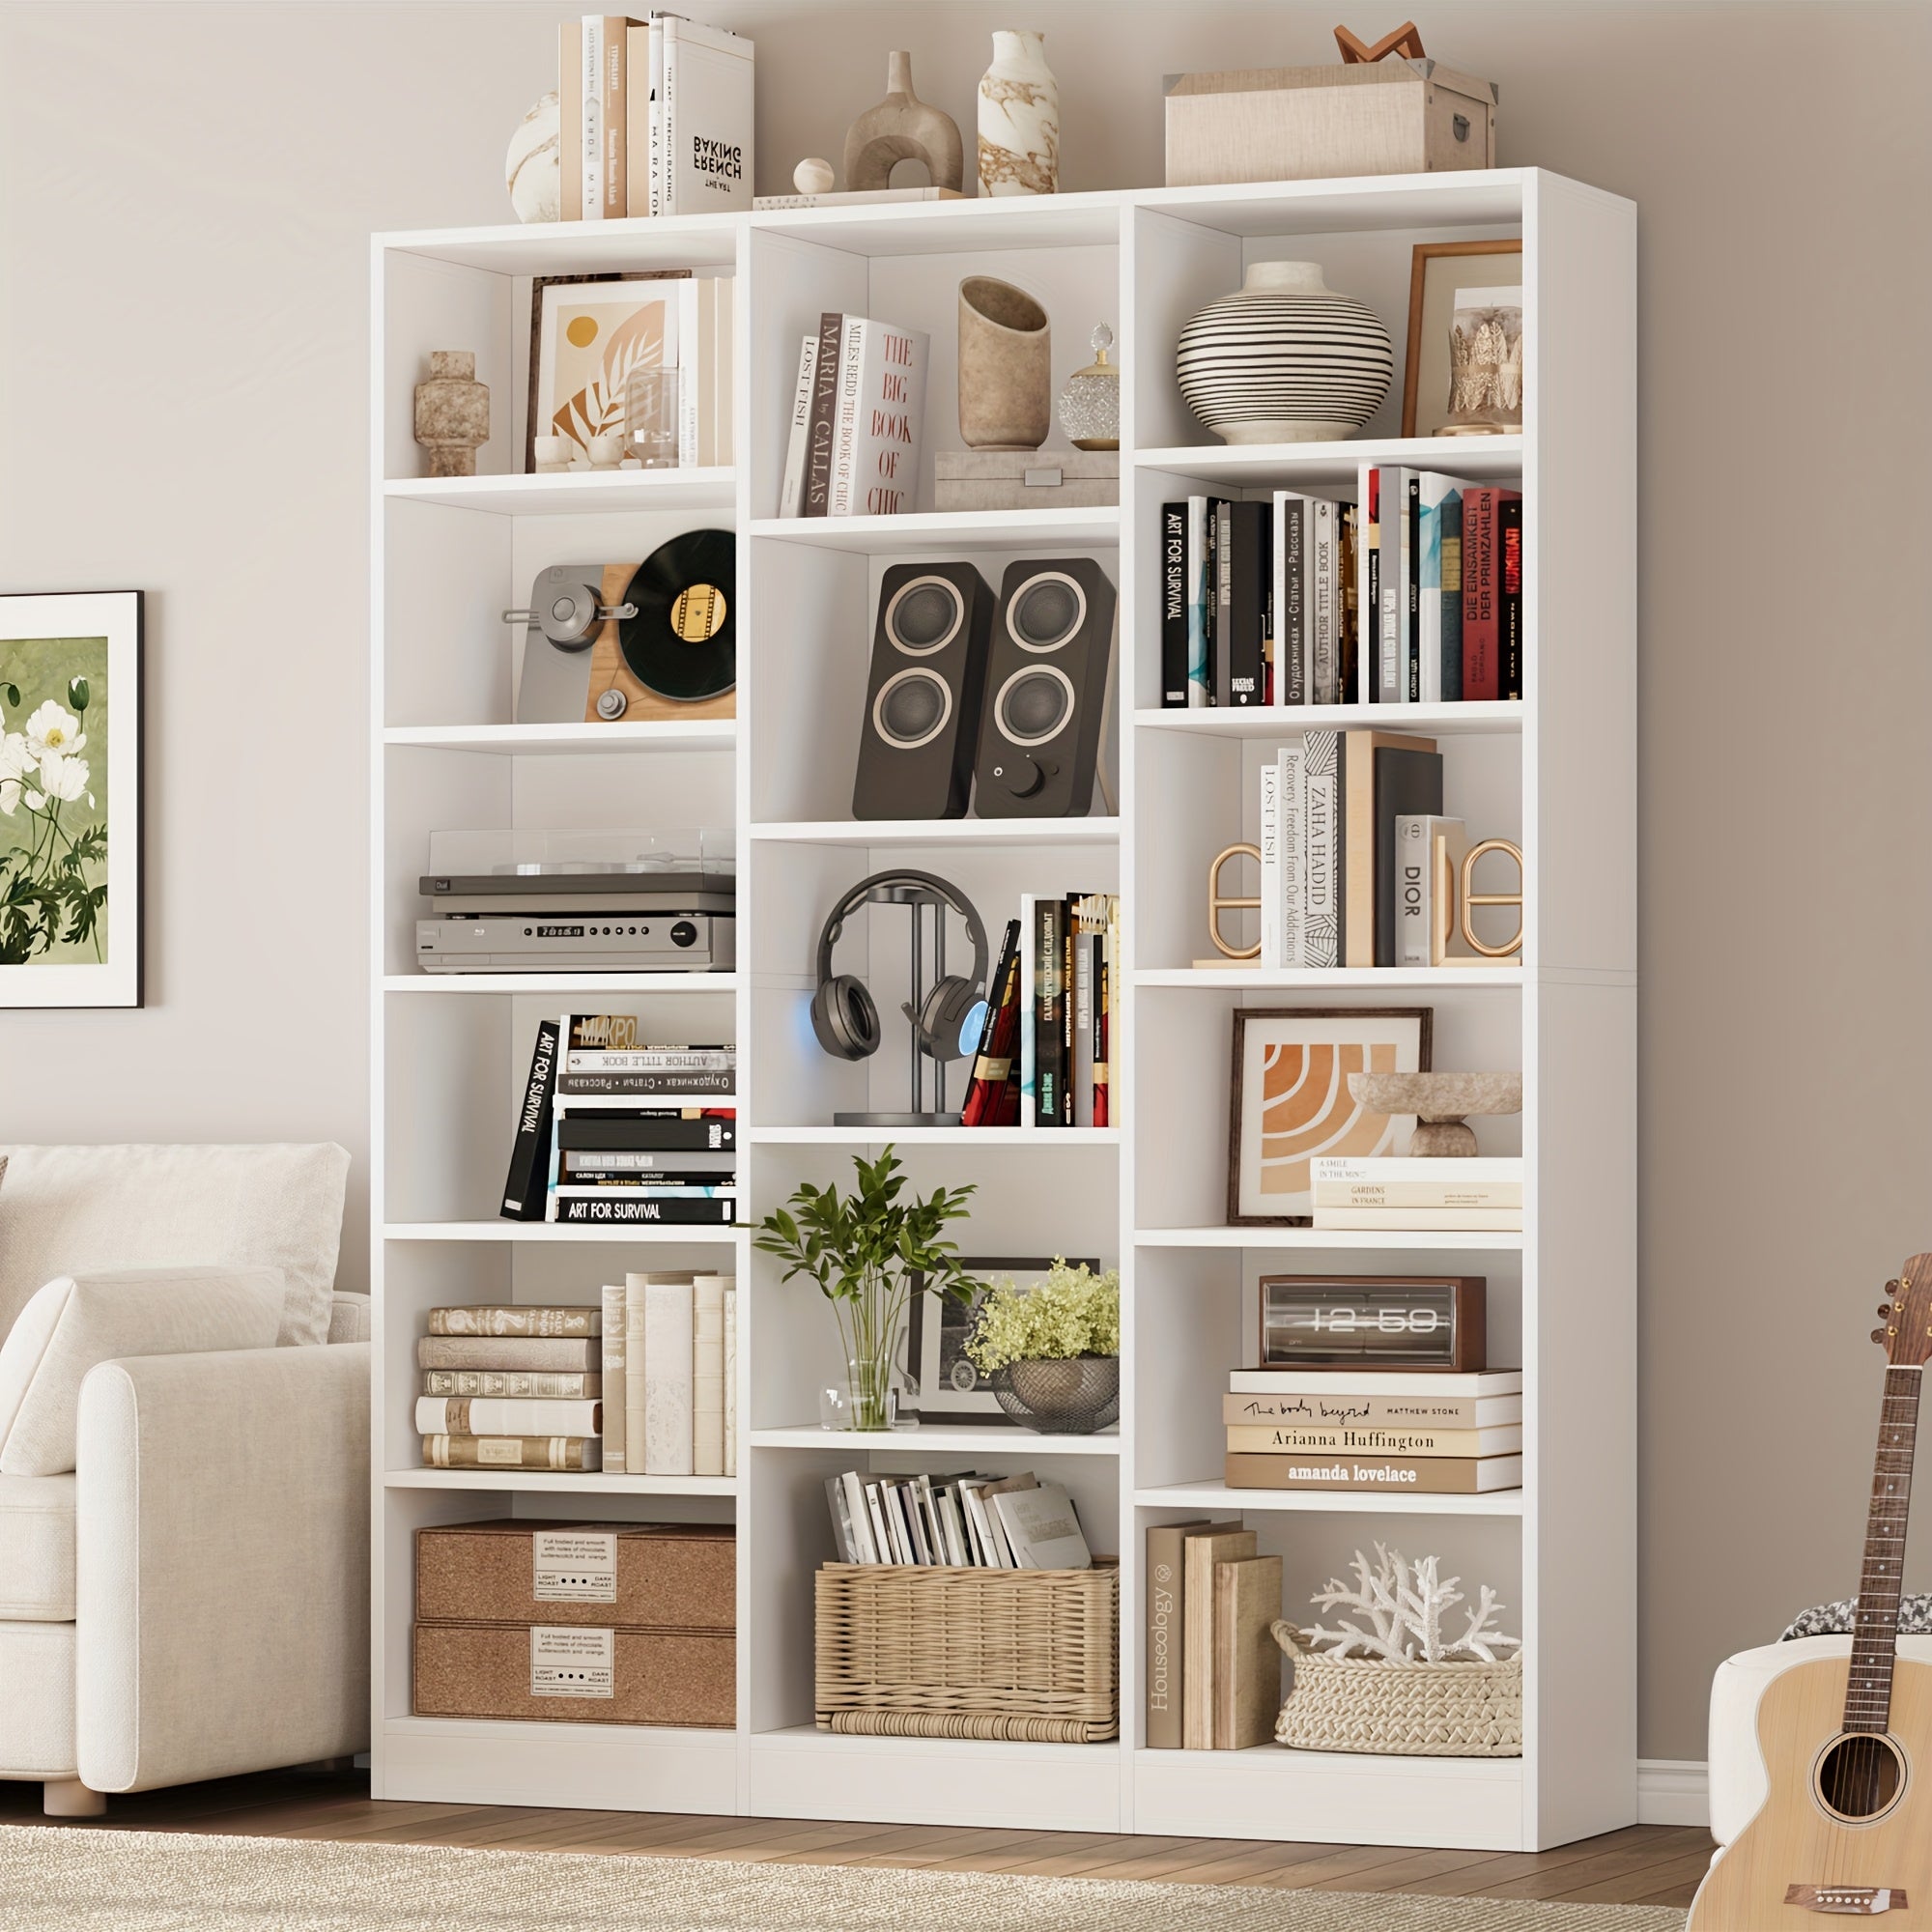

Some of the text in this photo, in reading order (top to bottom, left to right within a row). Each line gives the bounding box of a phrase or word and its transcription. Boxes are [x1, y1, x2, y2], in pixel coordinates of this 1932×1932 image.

[818, 325, 838, 397] MARIA
[883, 333, 913, 367] THE
[795, 341, 815, 426] LOST FISH
[882, 372, 907, 404] BIG
[835, 325, 863, 511] MILES REDD THE BOOK OF CHIC
[871, 409, 911, 443] BOOK
[811, 420, 832, 503] CALLAS
[878, 449, 899, 479] OF
[867, 486, 904, 515] CHIC
[1288, 512, 1300, 564] Рассказы
[1480, 492, 1492, 621] DER PRIMZAHLEN
[1167, 513, 1182, 620] ART FOR SURVIVAL
[1466, 506, 1478, 621] DIE EINSAMKEIT
[1288, 577, 1300, 614] Статьи
[1319, 541, 1329, 665] AUTHOR TITLE BOOK
[1292, 626, 1304, 690] художниках
[1264, 771, 1275, 866] LOST FISH
[1286, 808, 1298, 853] Freedom
[1312, 787, 1326, 905] ZAHA HADID
[1286, 855, 1298, 882] From
[1286, 885, 1298, 905] Our
[1405, 867, 1421, 917] DIOR
[1286, 907, 1298, 962] Addictions
[1043, 912, 1054, 1021] ГАЛАКТИЧЕСКИЙ СЛЕДОПЫТ
[581, 1016, 636, 1046] МИКРО
[603, 1056, 708, 1066] AUTHOR TITLE BOOK
[667, 1073, 720, 1086] художниках
[522, 1032, 554, 1133] ART FOR SURVIVAL
[568, 1077, 612, 1090] Рассказы
[623, 1077, 655, 1089] Статьи
[1350, 1186, 1385, 1195] GARDENS
[569, 1203, 661, 1218] ART FOR SURVIVAL
[1244, 1398, 1371, 1425] The body beyond
[1432, 1407, 1460, 1416] STONE
[1272, 1431, 1435, 1452] Arianna Huffington
[1288, 1464, 1417, 1483] amanda lovelace
[1151, 1586, 1173, 1712] Houseology
